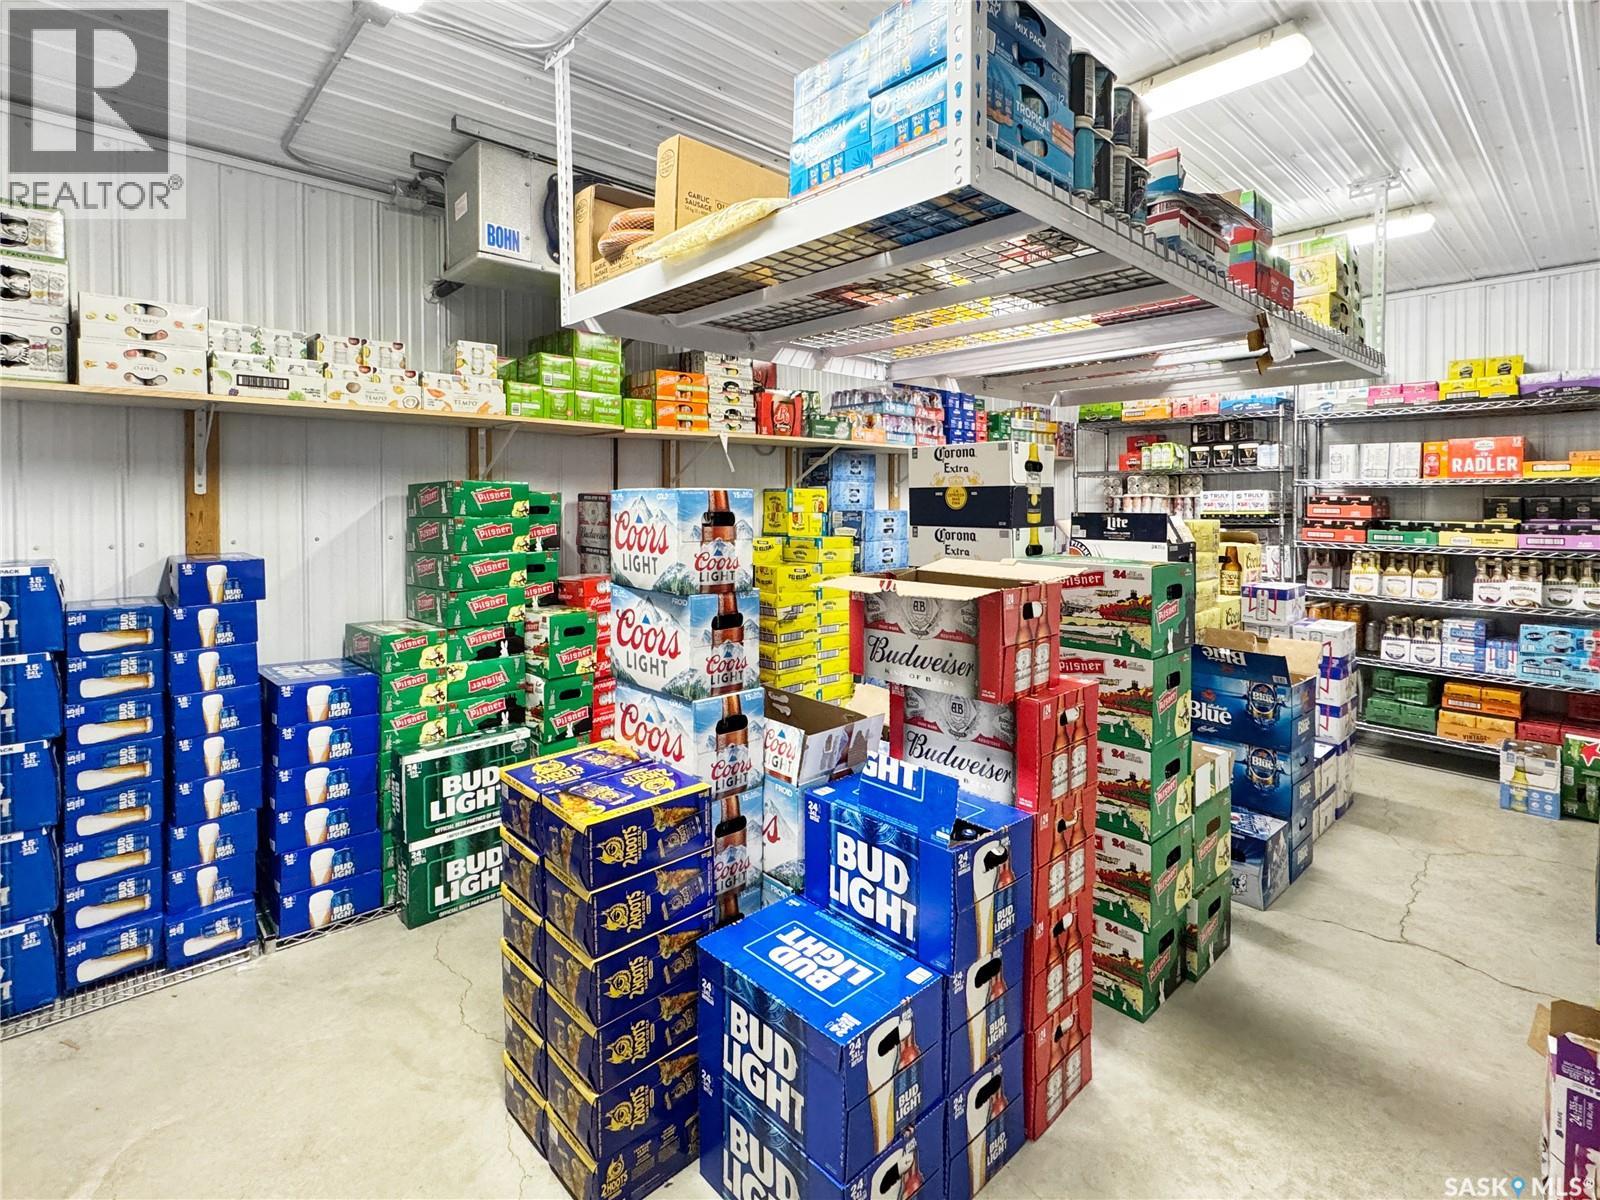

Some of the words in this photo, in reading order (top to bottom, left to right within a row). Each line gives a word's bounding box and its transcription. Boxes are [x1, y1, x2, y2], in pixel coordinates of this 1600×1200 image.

[1014, 22, 1028, 37] MIX
[1029, 31, 1047, 51] PACK
[1015, 101, 1050, 131] TROPICAL
[684, 197, 712, 211] SAUSAGE
[687, 191, 710, 204] GARLIC
[486, 223, 520, 252] BOHN
[364, 393, 388, 402] TEMPO
[453, 399, 478, 408] TEMPO
[934, 446, 976, 462] Corona
[943, 463, 969, 474] Extra
[1451, 455, 1518, 473] RADLER
[477, 489, 510, 502] Pilsner
[479, 525, 512, 538] Pilsner
[529, 525, 556, 538] ilsner
[1106, 516, 1129, 531] Lite
[614, 510, 669, 555] Coors
[934, 528, 977, 544] Corona
[944, 544, 970, 556] Extra
[474, 560, 508, 575] Pilsner
[622, 553, 658, 575] LIGHT
[694, 551, 740, 572] Coors
[699, 570, 735, 582] LIGHT
[1112, 569, 1127, 579] 24
[525, 585, 553, 597] ilsner
[472, 596, 507, 612] Pilsner
[120, 613, 129, 630] BUD
[468, 629, 504, 646] Pilsner
[616, 608, 681, 659] Coors
[394, 638, 427, 650] Pilsner
[561, 648, 592, 663] Pilsner
[867, 634, 975, 678] Budweiser
[1112, 658, 1128, 669] 24
[120, 658, 129, 675] BUD
[626, 650, 669, 678] LIGHT
[705, 655, 749, 675] Coors
[1060, 661, 1102, 672] Pilsner
[217, 674, 235, 682] BUD
[394, 675, 427, 689] Pilsner
[470, 674, 505, 691] Pilsner
[710, 670, 744, 685] LIGHT
[1252, 690, 1275, 702] Blue
[119, 702, 127, 720] BUD
[328, 707, 353, 718] LIGHT
[330, 702, 351, 711] BUD
[468, 701, 504, 718] Pilsner
[1190, 700, 1233, 725] Blue
[221, 715, 239, 724] BUD
[394, 712, 427, 728] Pilsner
[555, 709, 587, 726] Pilsner
[619, 702, 685, 762] Coors
[329, 748, 353, 759] LIGHT
[331, 742, 352, 752] BUD
[1111, 748, 1125, 759] 24
[119, 747, 128, 765] BUD
[221, 758, 240, 766] BUD
[906, 729, 1012, 784] Budweiser
[1251, 757, 1274, 770] Blue
[406, 763, 418, 772] 24
[711, 757, 753, 781] Coors
[329, 783, 349, 793] BUD
[442, 765, 501, 799] BUD
[715, 775, 749, 795] LIGHT
[774, 783, 793, 797] FROID
[119, 791, 128, 810] BUD
[326, 788, 351, 800] LIGHT
[221, 801, 239, 810] BUD
[430, 784, 501, 822] LIGH
[807, 800, 819, 812] 24
[327, 828, 351, 840] LIGHT
[329, 822, 349, 833] BUD
[117, 836, 126, 854] BUD
[216, 843, 234, 853] BUD
[622, 825, 639, 868] 2HOOTS
[1111, 837, 1126, 849] 24
[410, 851, 422, 860] 24
[836, 831, 911, 895] BUD
[958, 851, 969, 864] 24
[333, 861, 354, 872] BUD
[446, 846, 503, 883] BUD
[714, 855, 751, 880] Coors
[331, 868, 356, 880] LIGHT
[118, 880, 127, 899] BUD
[215, 887, 233, 896] BUD
[434, 865, 503, 907] LIGH
[333, 902, 353, 913] BUD
[829, 863, 917, 942] LIGHT
[331, 909, 356, 921] LIGHT
[626, 890, 643, 934] 2HOOTS
[996, 909, 1014, 922] BUD
[994, 914, 1016, 934] LIGHT
[1105, 921, 1119, 935] 24
[120, 931, 129, 950] BUD
[775, 926, 876, 988] LIGHT
[768, 945, 842, 992] BUD
[629, 955, 645, 1000] 2HOOTS
[701, 978, 712, 991] 24
[988, 1014, 1007, 1031] BUD
[730, 1000, 799, 1082] BUD
[986, 1021, 1008, 1046] LIGHT
[632, 1019, 647, 1065] 2HOOTS
[849, 1038, 862, 1055] 24
[701, 1069, 712, 1084] 24
[722, 1032, 805, 1135] LIGHT
[898, 1083, 919, 1106] BUD
[630, 1085, 646, 1131] 2HOOTS
[895, 1089, 922, 1123] LIGHT
[953, 1096, 964, 1110] 24
[988, 1132, 1007, 1152] BUD
[730, 1115, 801, 1200] BUD
[986, 1138, 1009, 1167] LIGHT
[601, 1167, 629, 1197] 2HOOTS
[850, 1176, 865, 1192] 24
